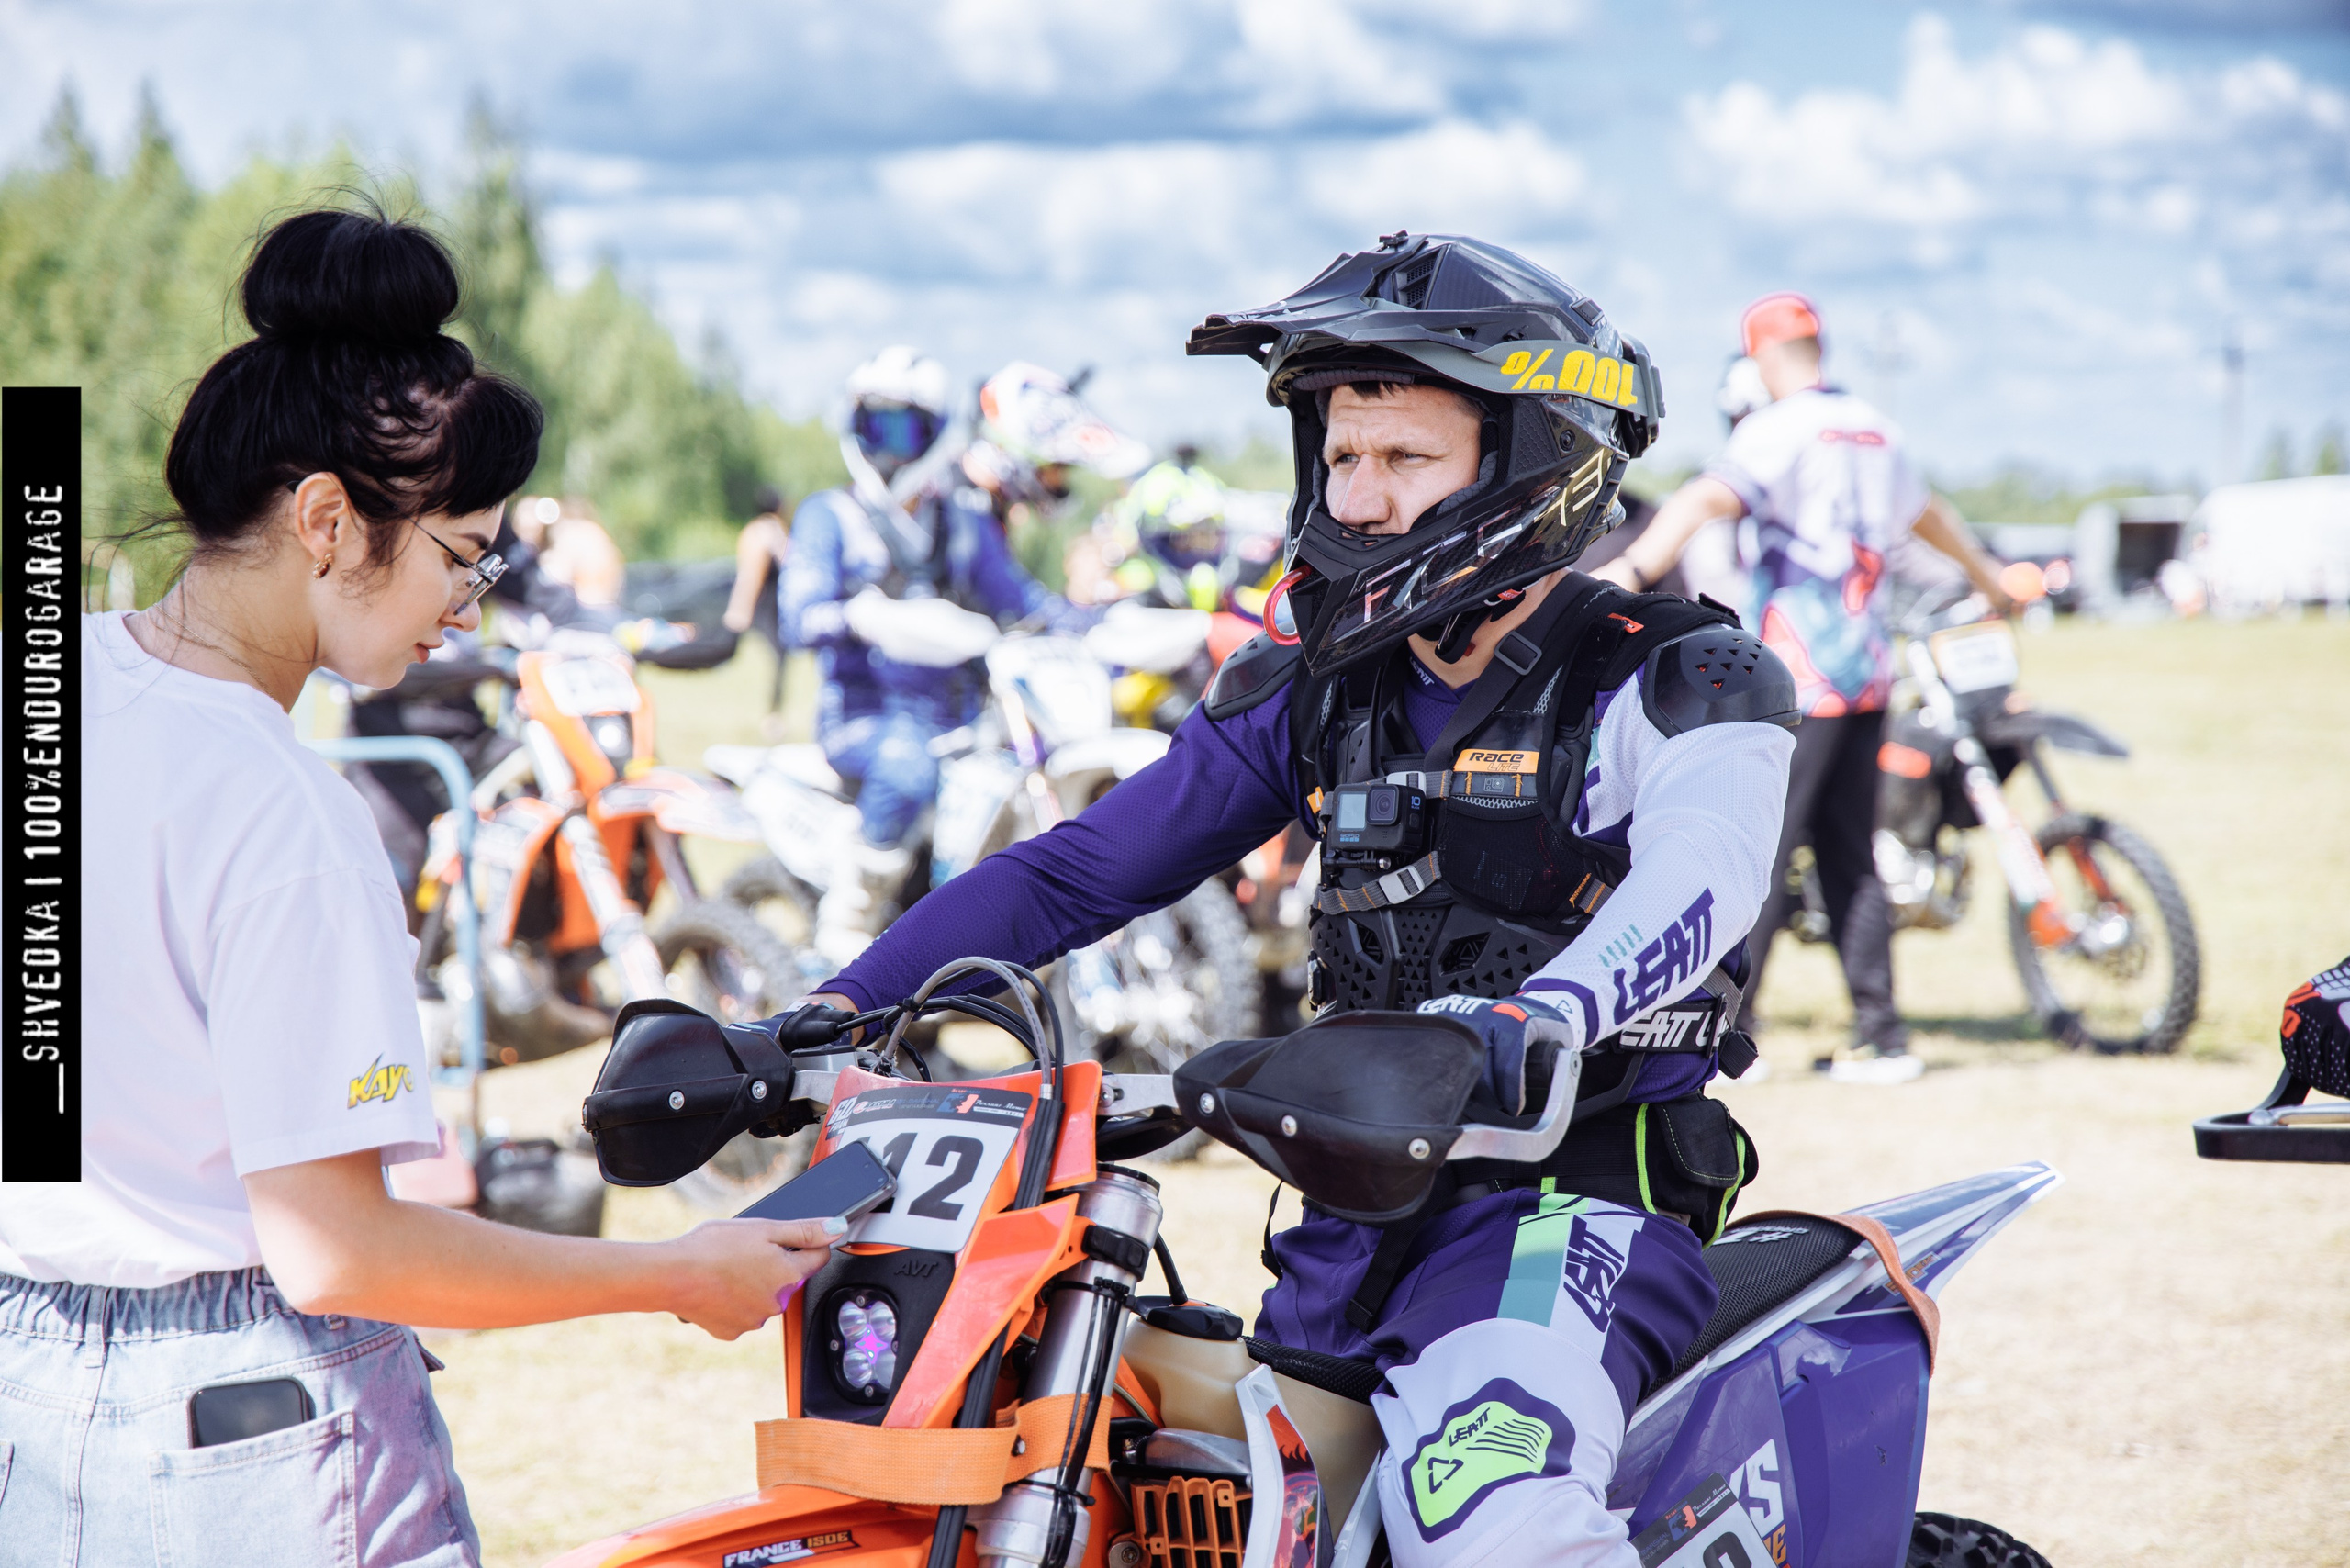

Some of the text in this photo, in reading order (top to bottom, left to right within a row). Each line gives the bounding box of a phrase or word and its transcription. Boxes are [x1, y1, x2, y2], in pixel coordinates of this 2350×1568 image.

[1500, 348, 1638, 407] 100%
[1487, 763, 1520, 772] LITE
[1411, 795, 1421, 806] 10
[1614, 887, 1715, 1026] LEATT
[1417, 994, 1494, 1014] LEATT
[1619, 1011, 1704, 1047] EATT
[856, 1132, 984, 1221] 12
[894, 1261, 939, 1278] AVT
[1449, 1407, 1491, 1447] LEATT
[724, 1531, 849, 1568] FRANCE ISDE
